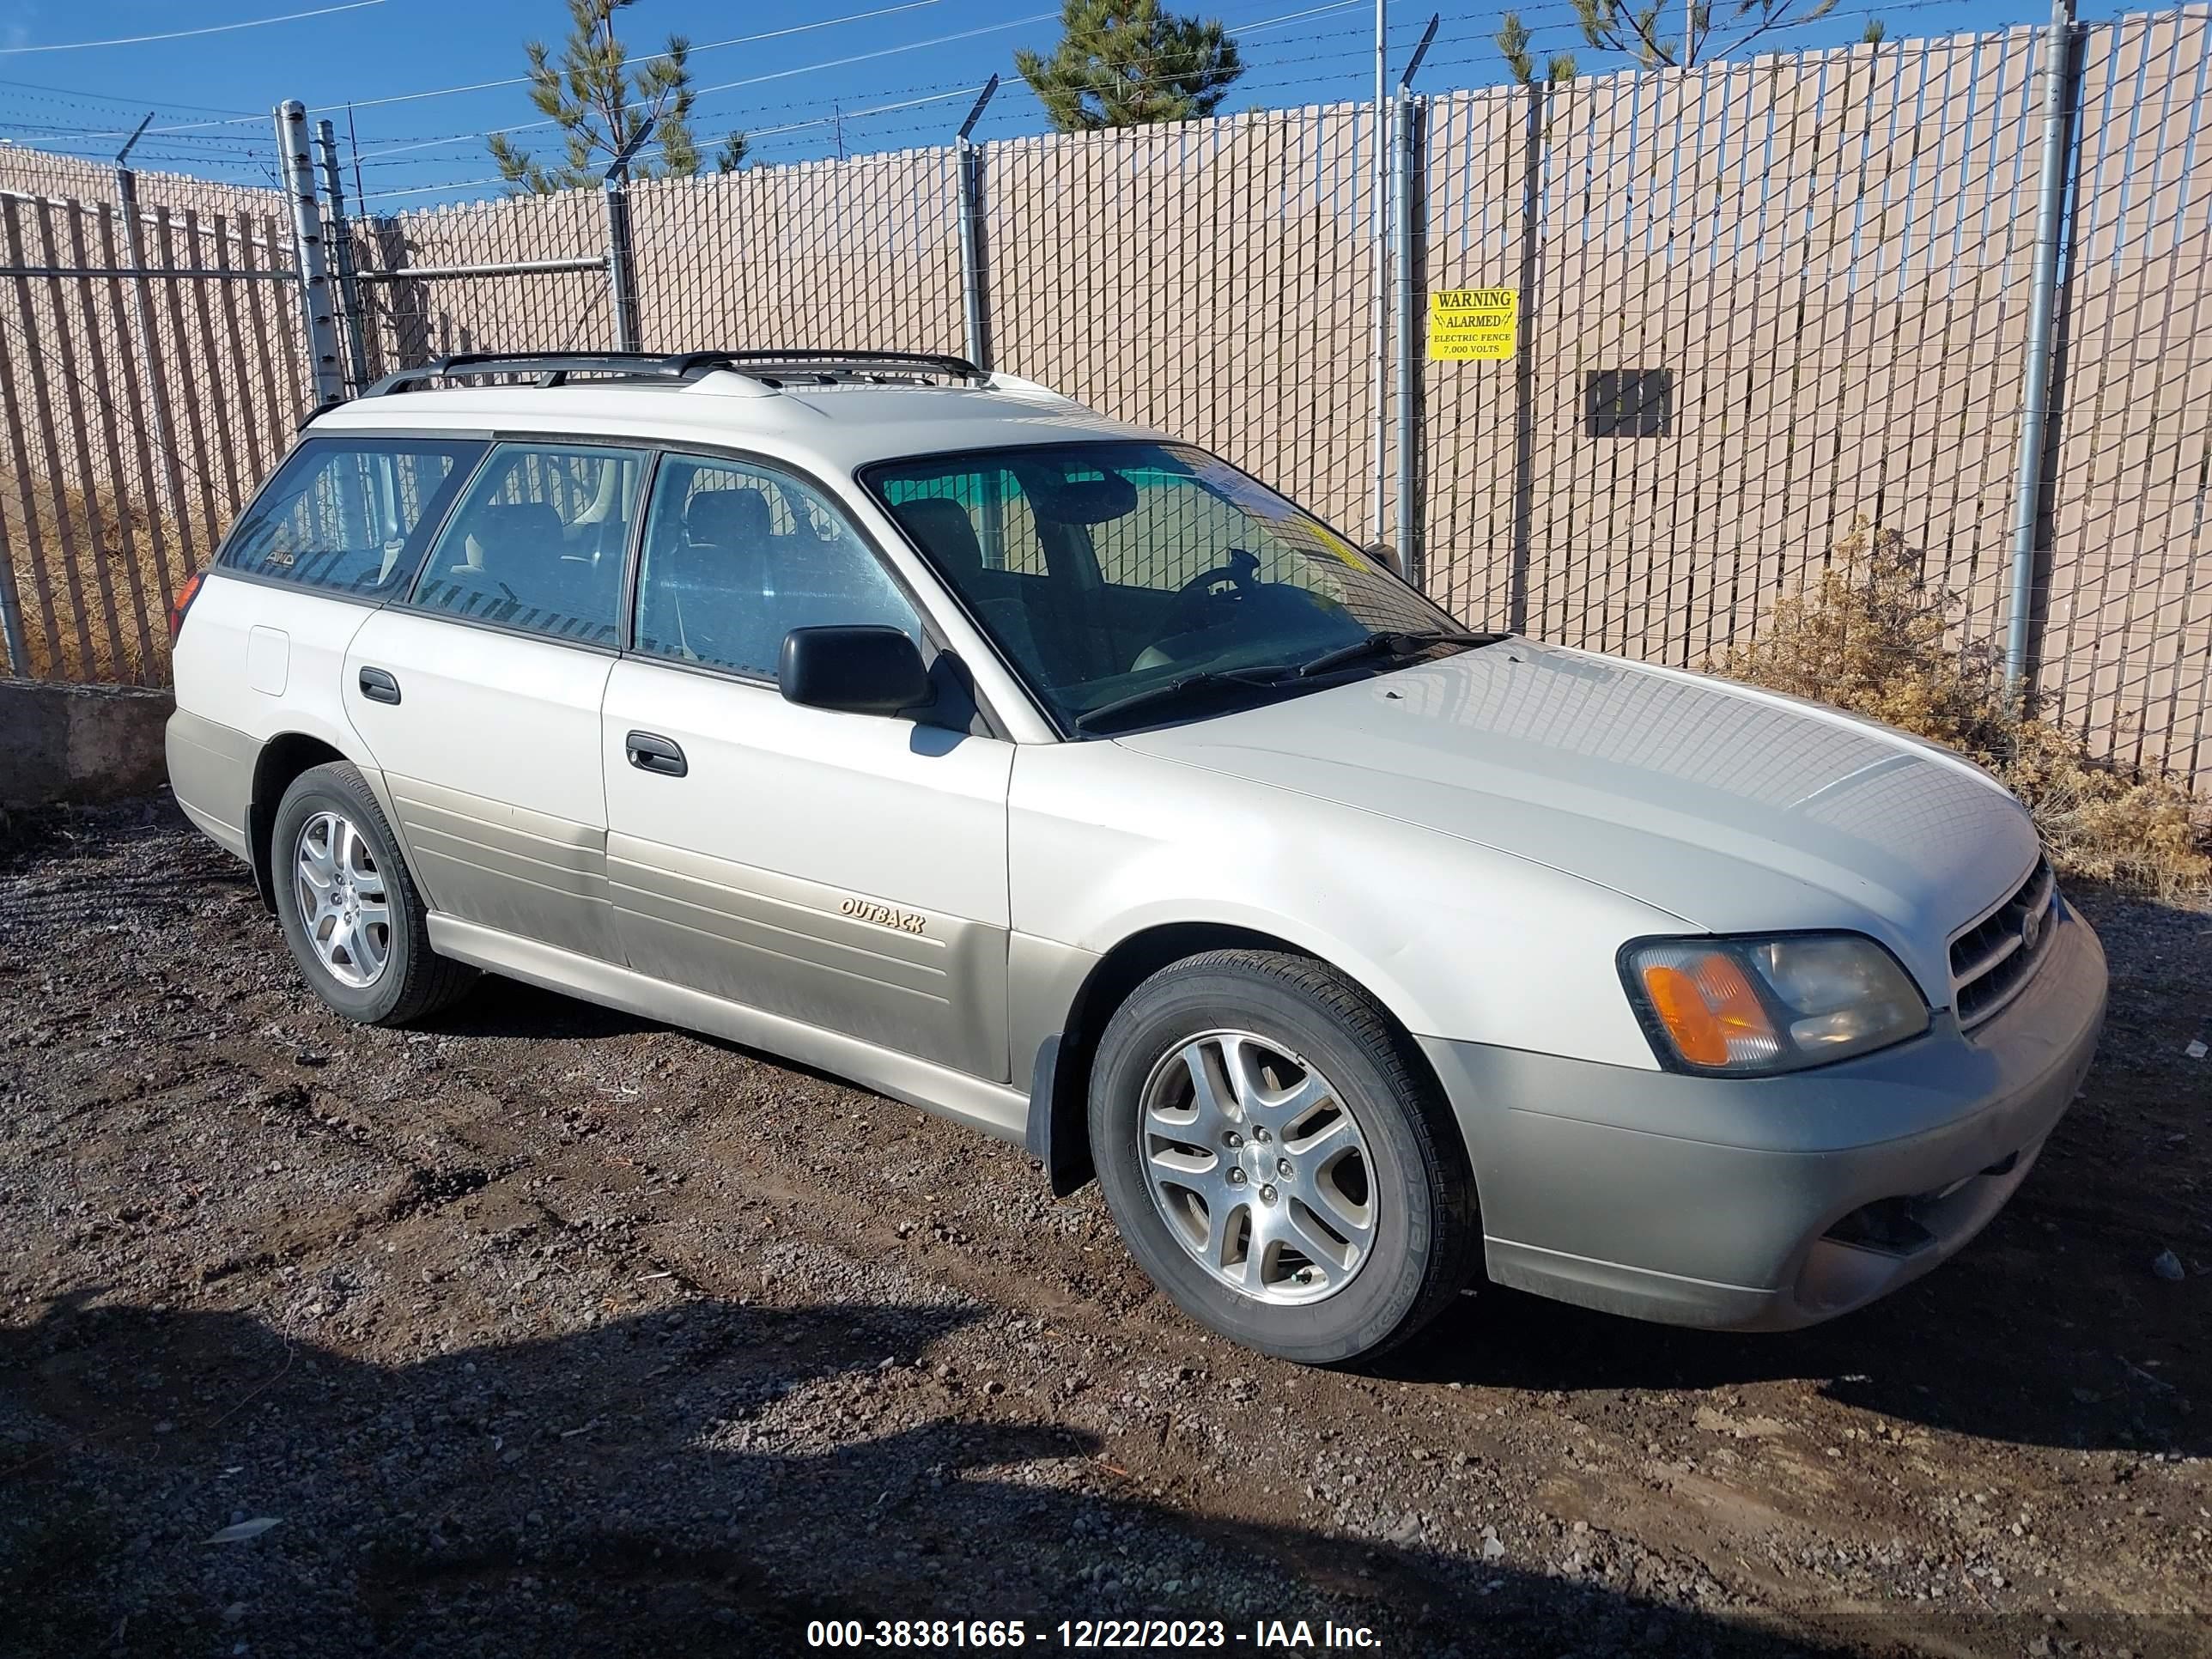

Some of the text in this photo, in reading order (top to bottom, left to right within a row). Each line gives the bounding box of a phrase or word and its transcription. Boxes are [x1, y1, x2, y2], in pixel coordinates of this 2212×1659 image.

[1438, 292, 1511, 307] WARNING
[1446, 315, 1501, 328] ALARMED
[1434, 334, 1479, 343] ELECTRIC
[1443, 344, 1500, 354] 7,000 VOLTS
[266, 551, 295, 565] AWD
[839, 897, 927, 934] OUTBACK
